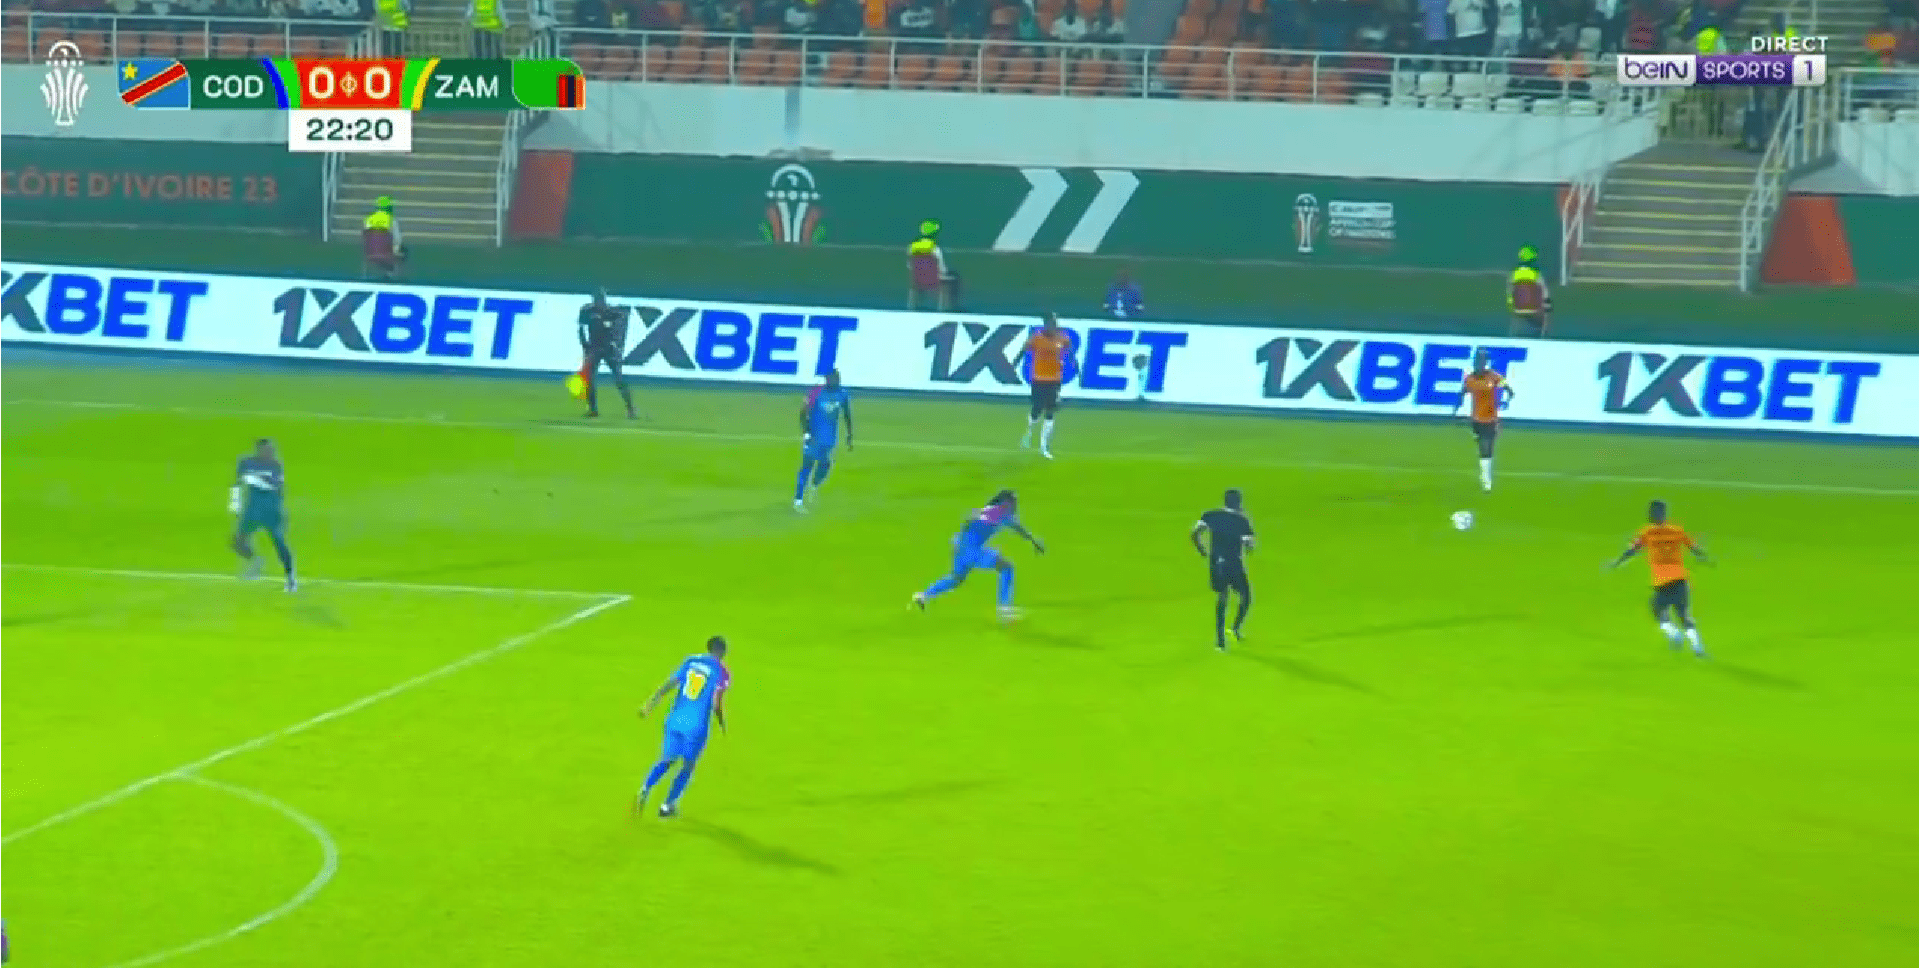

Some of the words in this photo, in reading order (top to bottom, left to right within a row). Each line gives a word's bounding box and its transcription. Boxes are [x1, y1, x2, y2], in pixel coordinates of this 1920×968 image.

[1, 165, 79, 197] CÔTE
[88, 172, 233, 200] D'IVOIRE
[242, 175, 278, 201] 23
[273, 286, 534, 360] 1XBET
[605, 304, 859, 376] XBET
[1598, 351, 1881, 423] 1XBET
